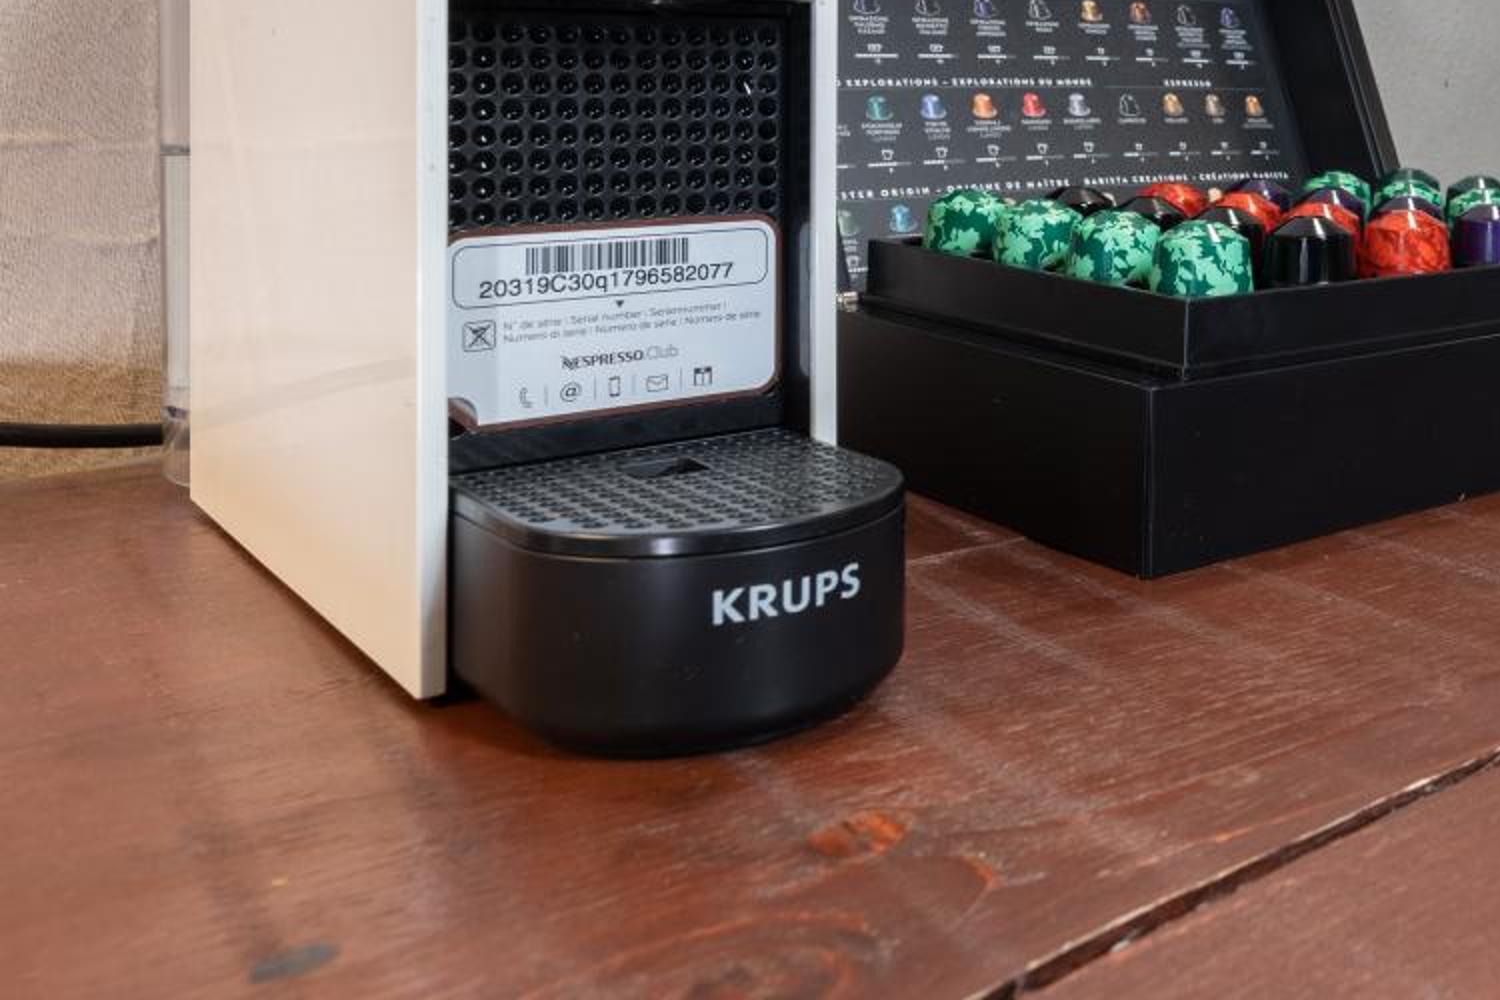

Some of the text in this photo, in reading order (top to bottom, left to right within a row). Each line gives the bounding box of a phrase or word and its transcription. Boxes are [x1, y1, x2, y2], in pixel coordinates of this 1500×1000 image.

[846, 79, 938, 87] EXPLORATIONS
[952, 77, 1035, 87] EXPLORATIONS
[1084, 176, 1129, 185] BARISTA
[1132, 173, 1188, 184] CREATIONS
[880, 186, 930, 197] ORIGIN
[479, 262, 734, 299] 20319C30q1796582077
[560, 349, 644, 370] NESPRESSO
[712, 563, 861, 626] KRUPS
